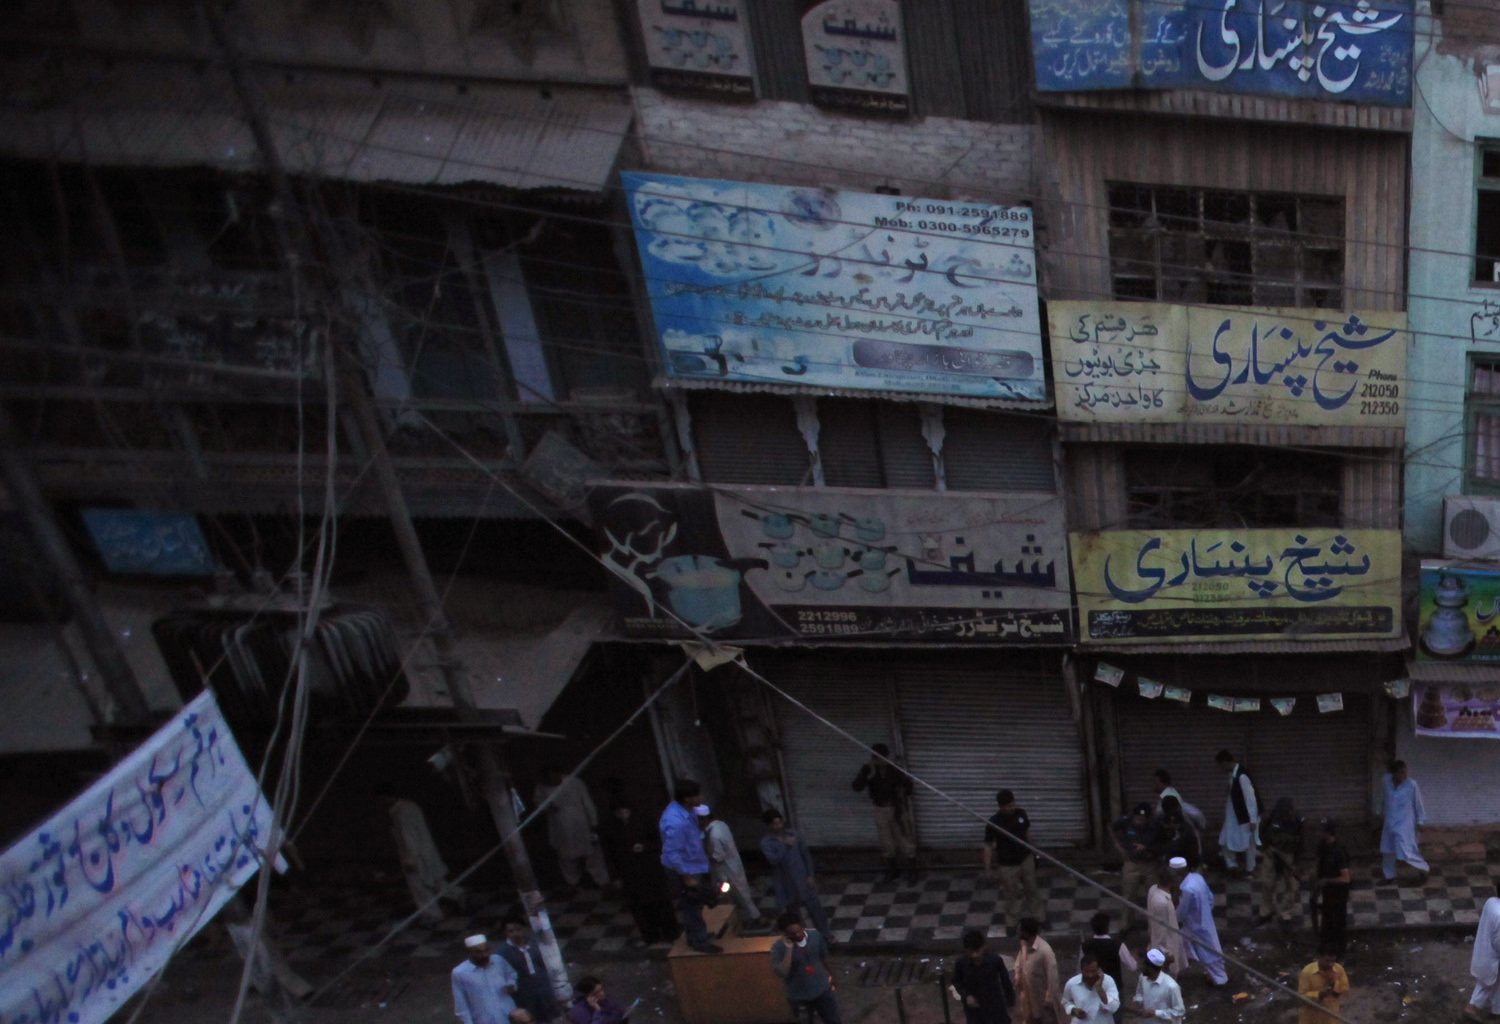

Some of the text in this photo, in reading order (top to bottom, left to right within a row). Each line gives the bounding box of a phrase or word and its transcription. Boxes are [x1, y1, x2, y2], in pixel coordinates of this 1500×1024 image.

[896, 203, 1028, 222] Ph: 091-2591889
[875, 217, 1030, 238] Mob: 0300-5965279
[1184, 314, 1397, 411] شیخ پنساری
[1361, 383, 1399, 398] 212050
[1360, 400, 1399, 416] 212350
[1104, 533, 1371, 604] شیخ پنساری
[797, 610, 857, 622] 2212996
[1017, 613, 1066, 638] شیخ
[800, 622, 860, 634] 2591889
